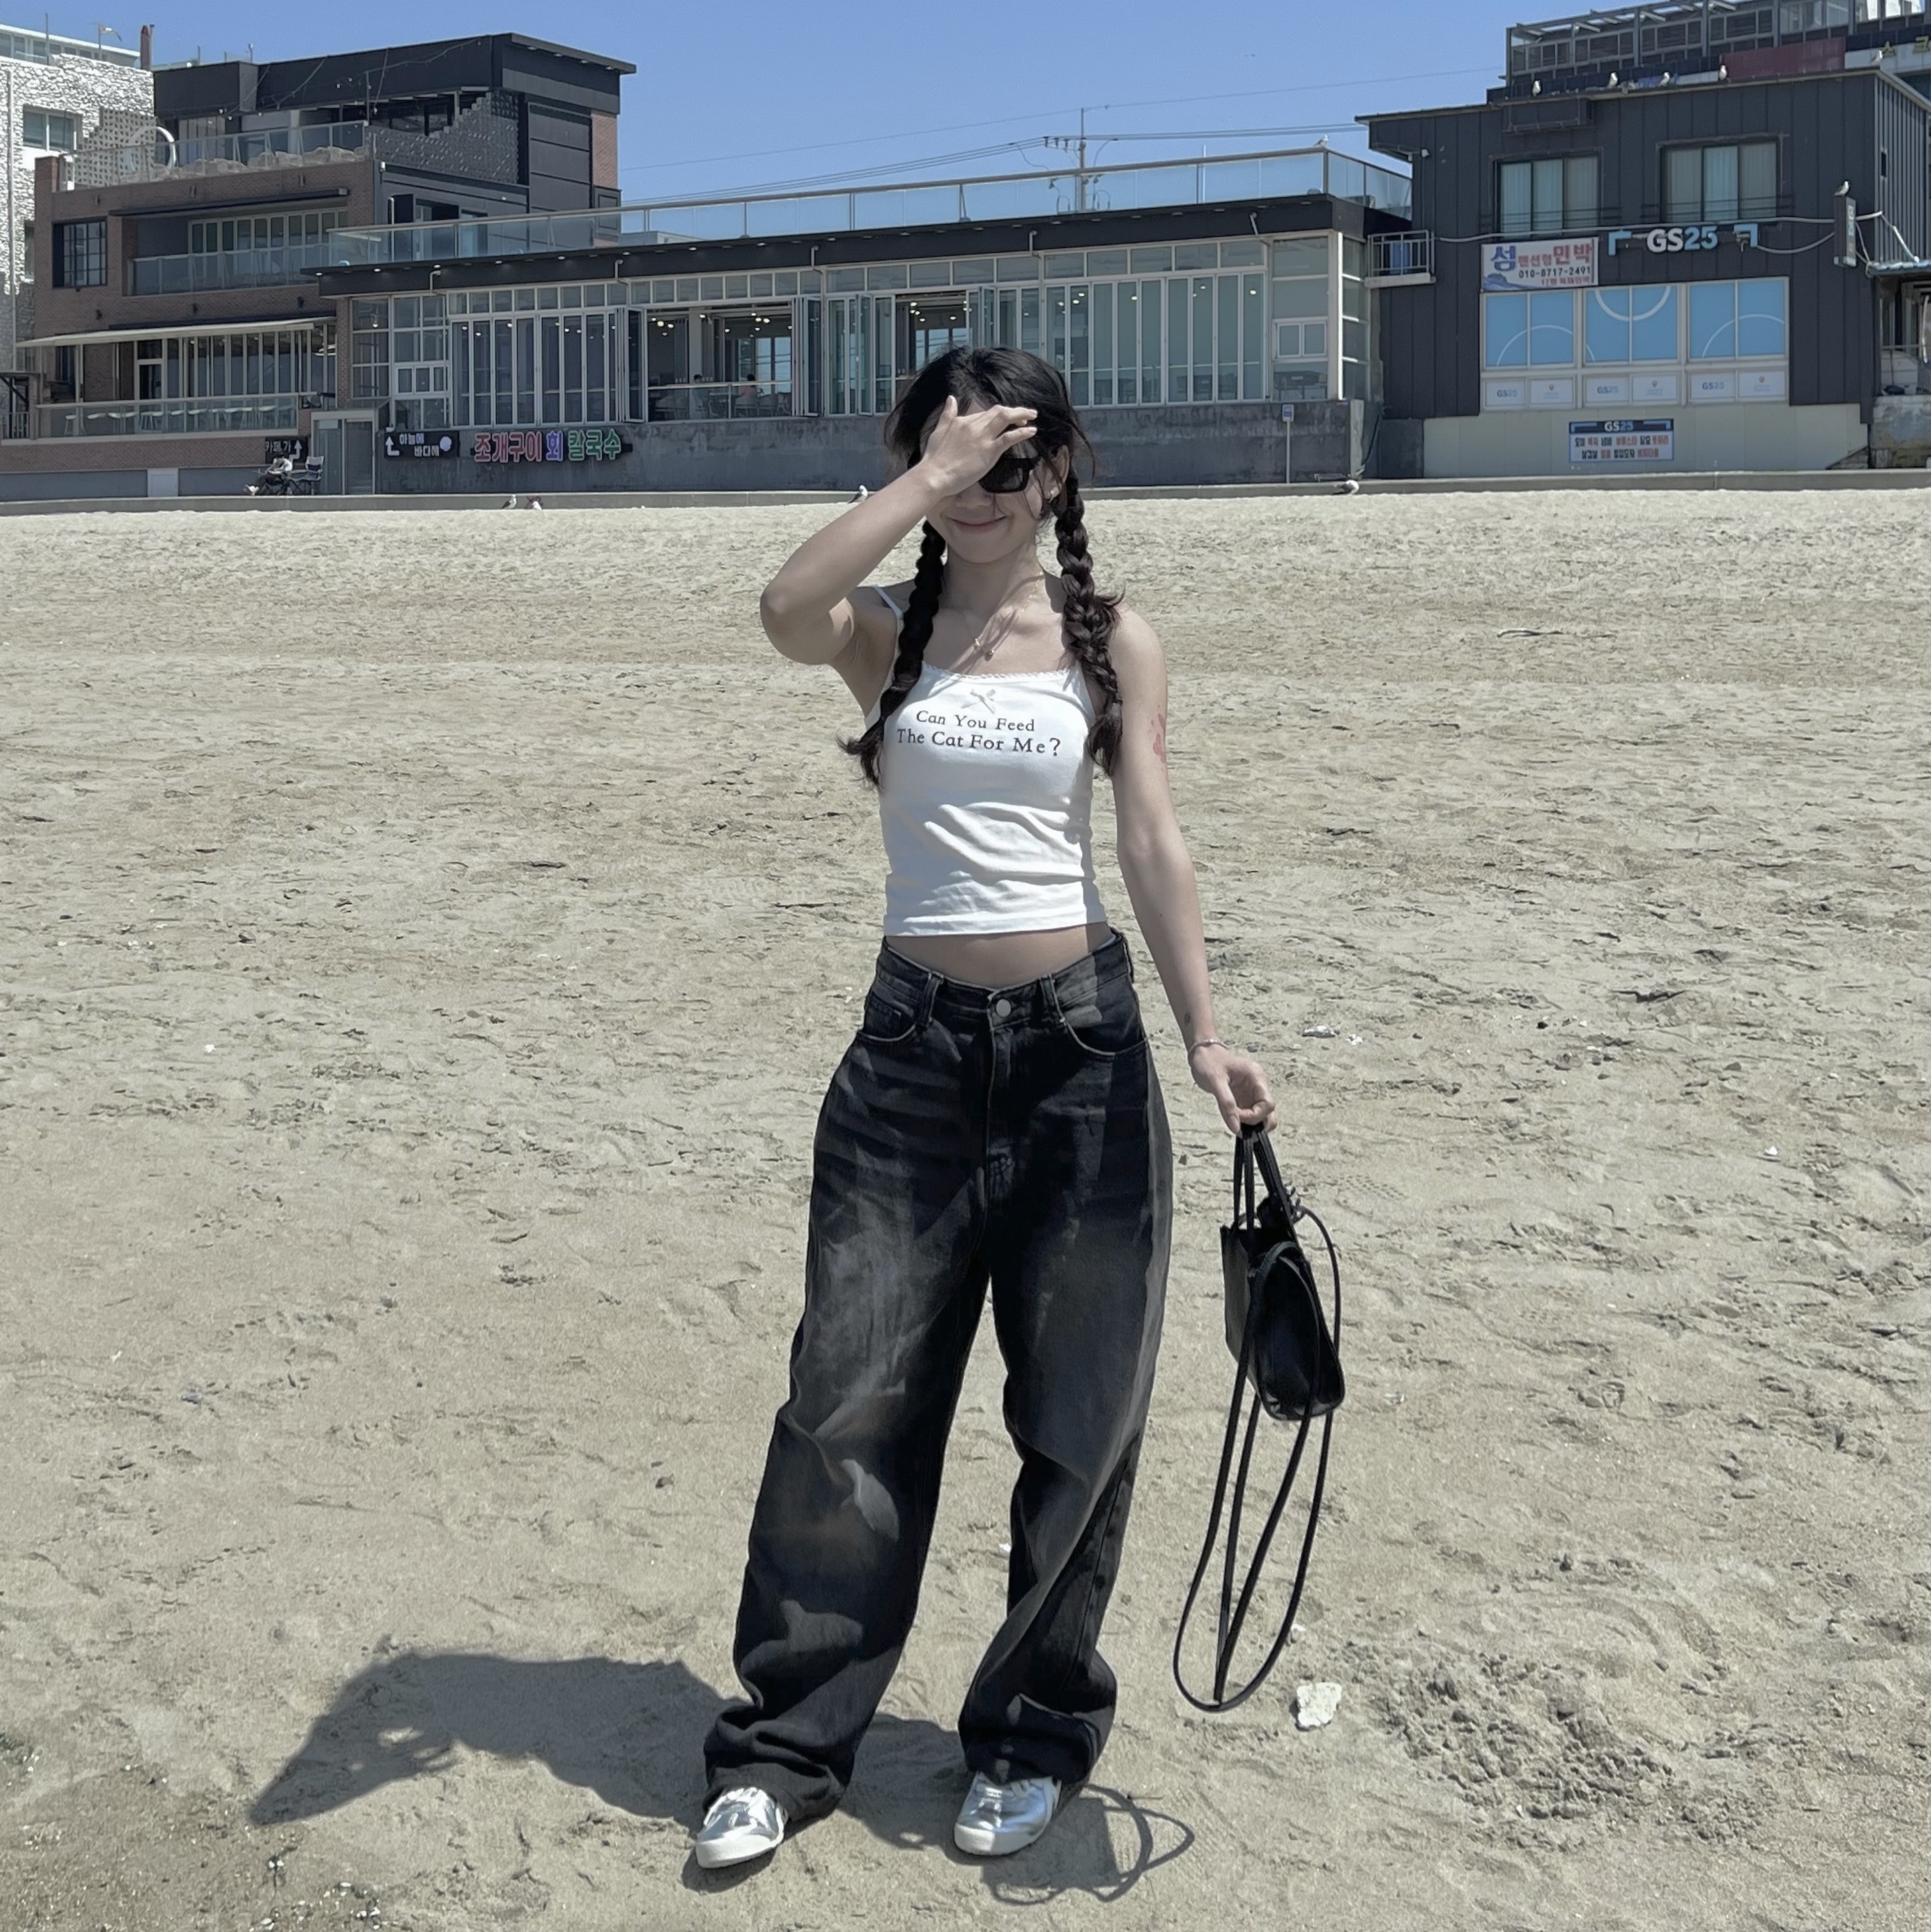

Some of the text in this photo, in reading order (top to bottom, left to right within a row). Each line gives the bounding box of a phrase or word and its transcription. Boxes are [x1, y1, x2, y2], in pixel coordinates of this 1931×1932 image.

[1647, 226, 1718, 253] GS25
[1490, 243, 1592, 271] 섬 펜션형 민박
[1519, 266, 1590, 278] 010-8717-2491
[1497, 389, 1518, 398] GS25
[1597, 385, 1619, 394] GS25
[1702, 381, 1725, 390] GS25
[1604, 420, 1634, 432] GS25
[473, 428, 622, 463] 조개구이 회 칼국수
[916, 709, 1035, 732] Can You Feed
[897, 728, 1061, 756] The Cat For Me?
